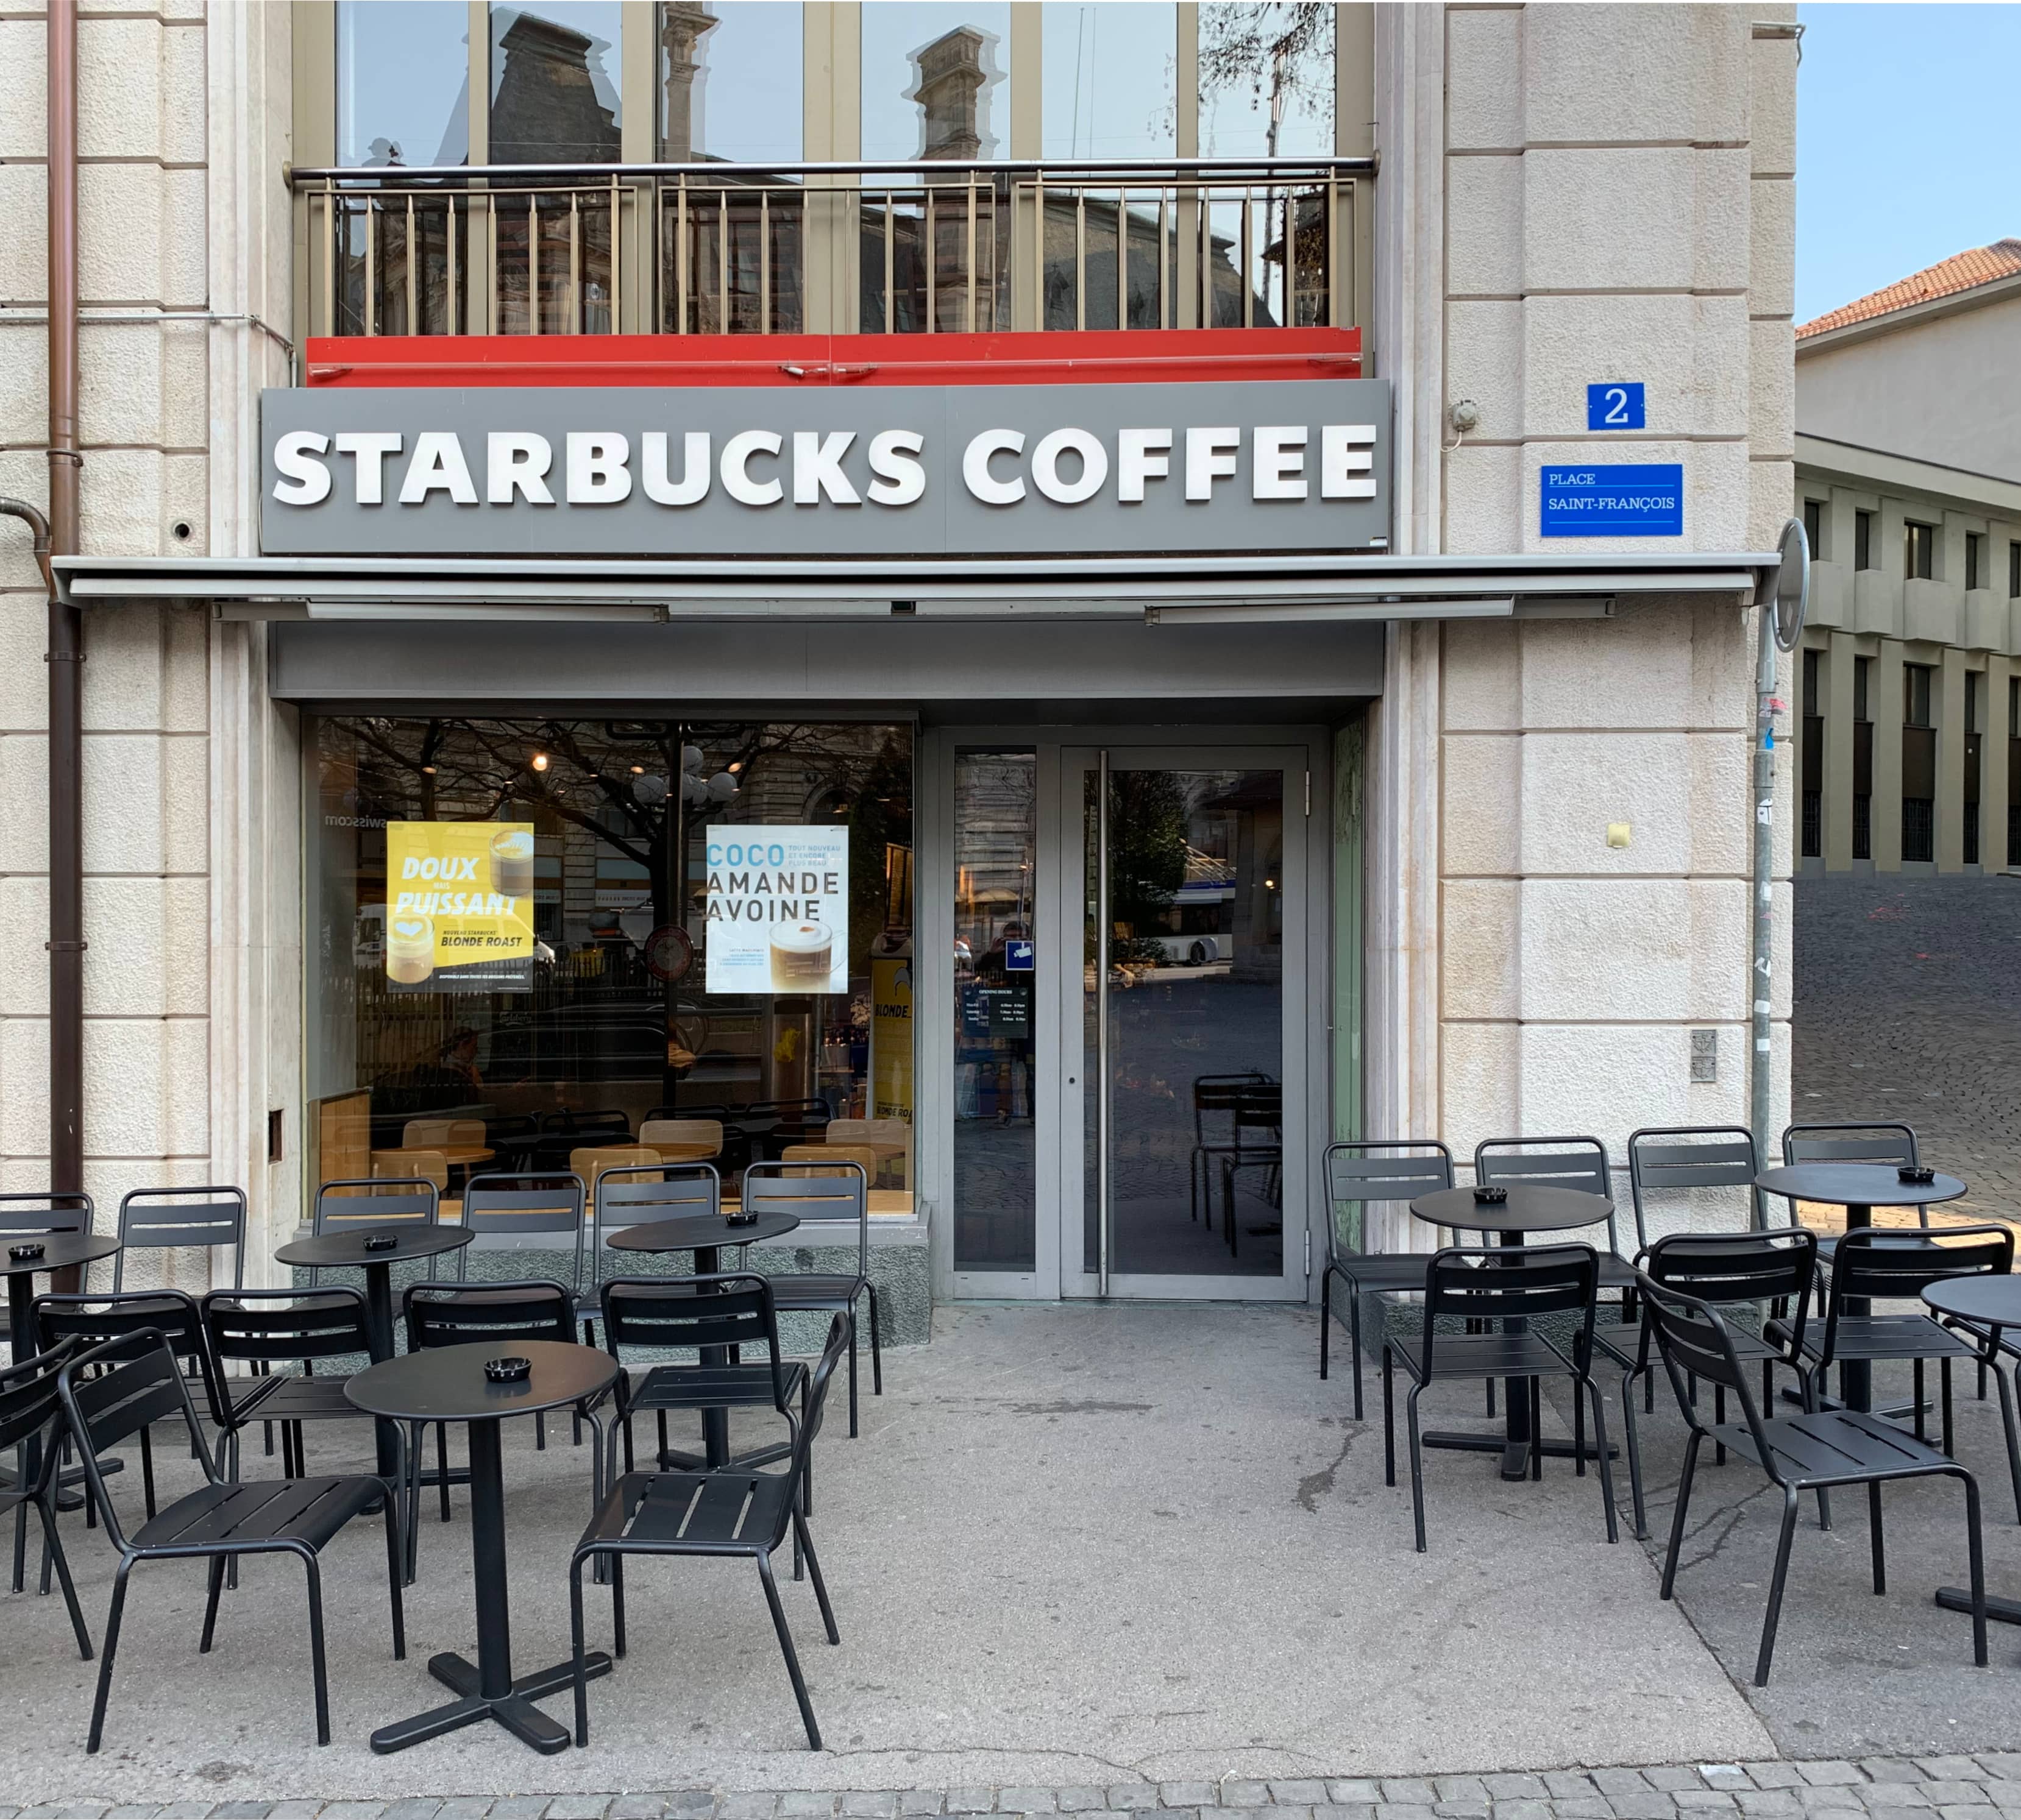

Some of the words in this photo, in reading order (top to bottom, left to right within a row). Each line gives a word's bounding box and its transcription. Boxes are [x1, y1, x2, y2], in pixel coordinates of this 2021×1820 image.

[1605, 388, 1629, 423] 2
[272, 430, 926, 506] STARBUCKS
[963, 425, 1377, 506] COFFEE
[1549, 473, 1596, 485] PLACE
[1548, 497, 1675, 512] SAINT-FRANÇOIS
[707, 844, 784, 866] COCO
[401, 857, 480, 880] DOUX
[707, 872, 839, 894] AMANDE
[396, 892, 519, 916] PUISSANT
[706, 900, 820, 922] AVOINE
[441, 937, 483, 946] BLONDE
[486, 937, 523, 946] ROAST
